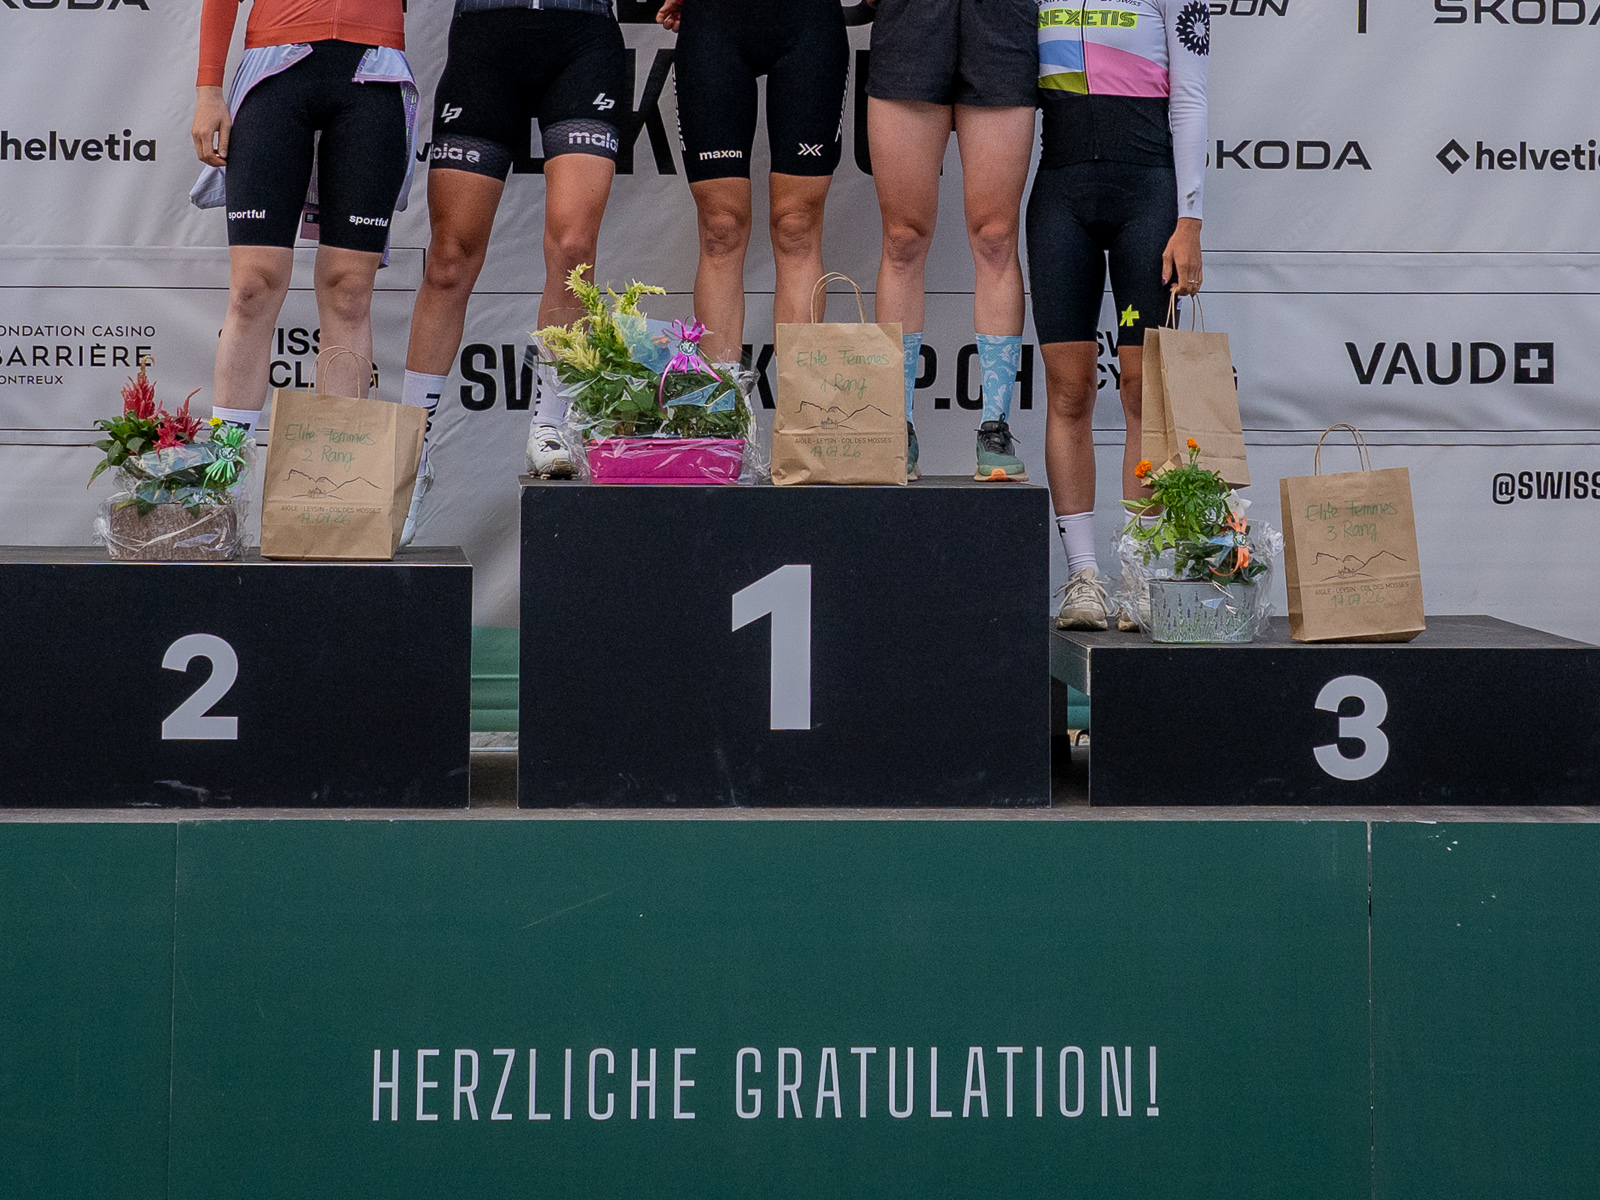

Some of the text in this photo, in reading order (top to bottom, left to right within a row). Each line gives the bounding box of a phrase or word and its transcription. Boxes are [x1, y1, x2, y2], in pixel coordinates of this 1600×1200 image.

[1038, 8, 1137, 29] NEXETIS
[1, 128, 157, 162] helvetia
[568, 131, 619, 153] malo
[700, 150, 743, 161] maxon
[1206, 139, 1373, 171] KODA
[1475, 139, 1600, 171] helveti
[228, 209, 266, 221] sportful
[349, 215, 389, 227] sportful
[92, 325, 156, 338] CASINO
[0, 342, 152, 367] ARRIÈRE
[796, 347, 890, 367] Elite Femmes
[1345, 341, 1507, 386] VAUD
[820, 373, 867, 400] 1 Rang
[285, 423, 376, 446] Elite Femmes
[302, 445, 356, 472] 2 Rang
[1305, 500, 1398, 521] Elite Femmes
[1327, 520, 1377, 542] 3 Rang
[731, 564, 812, 731] 1
[161, 632, 239, 740] 2
[1312, 674, 1390, 781] 3
[372, 1046, 1160, 1122] HERZLICHE GRATULATION!
